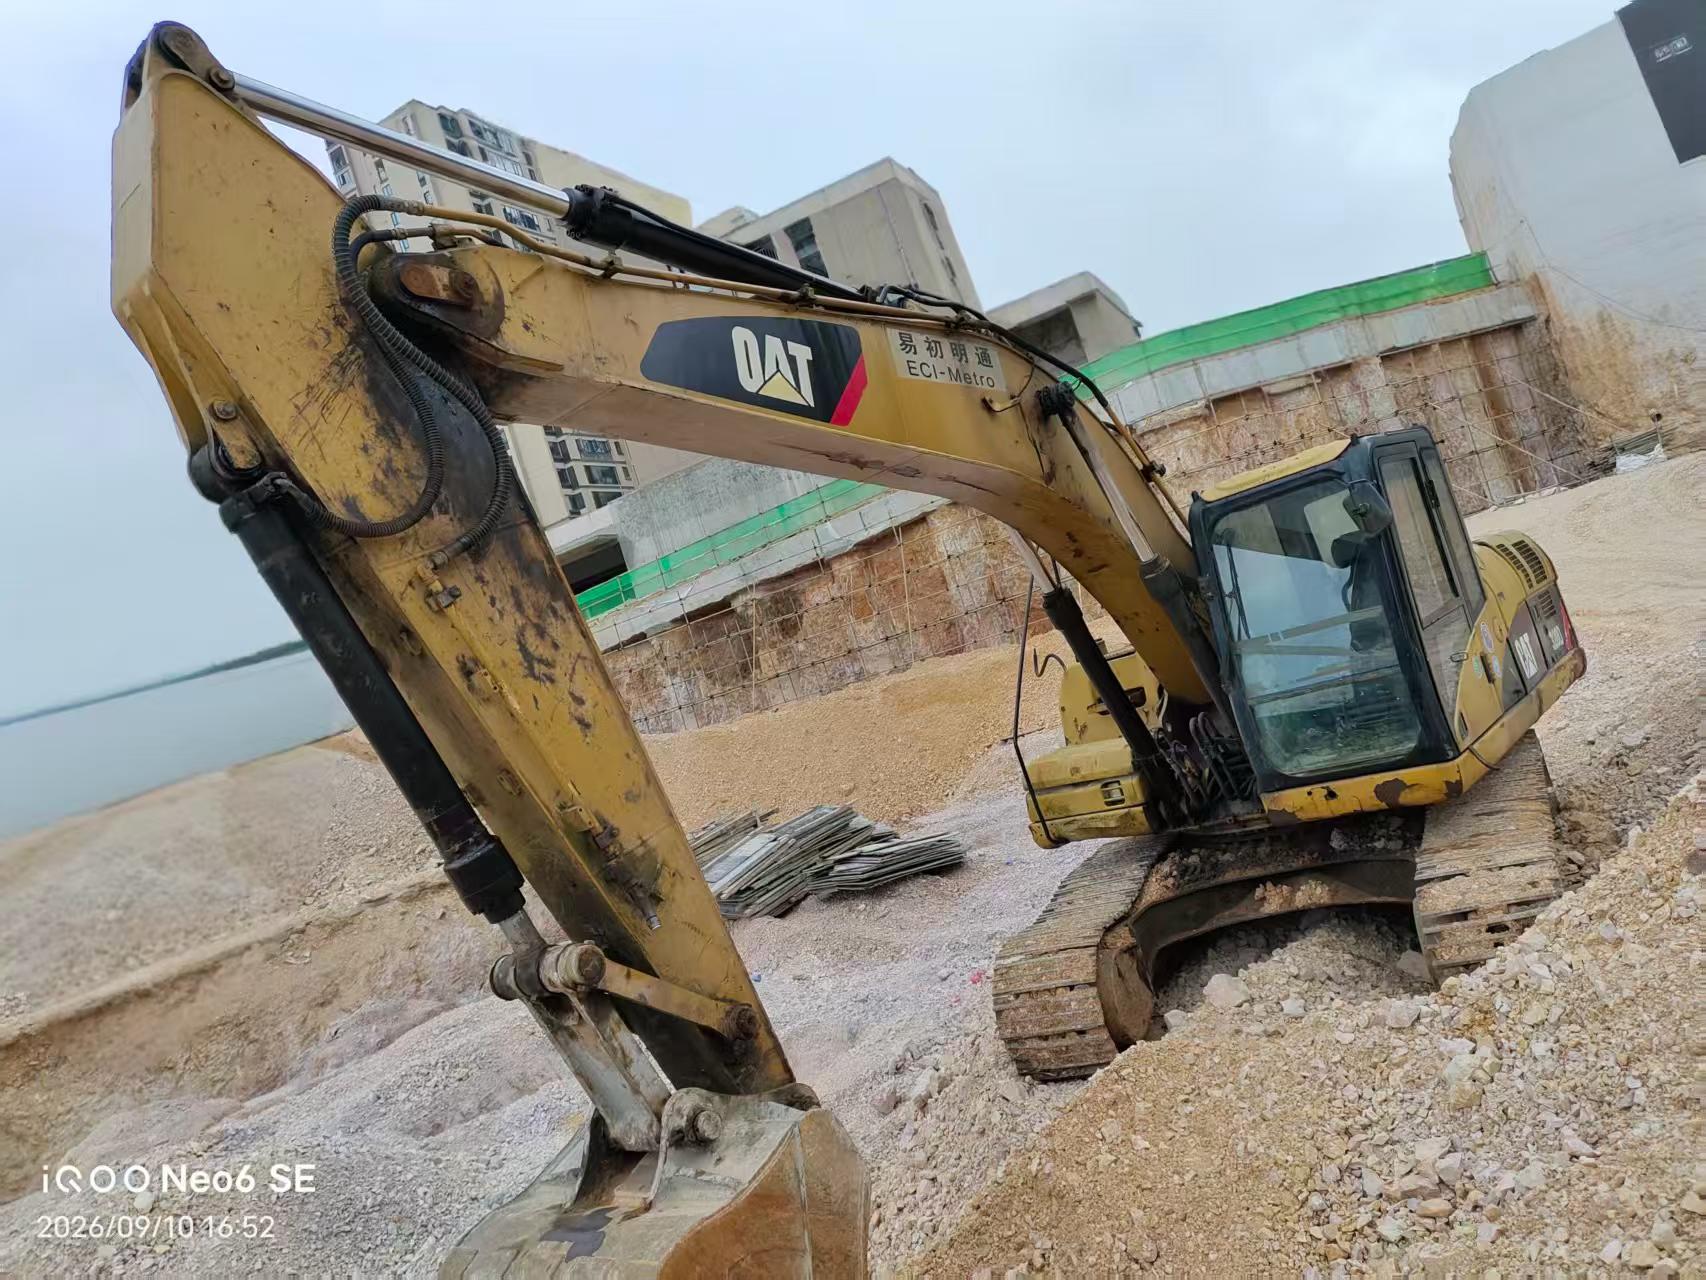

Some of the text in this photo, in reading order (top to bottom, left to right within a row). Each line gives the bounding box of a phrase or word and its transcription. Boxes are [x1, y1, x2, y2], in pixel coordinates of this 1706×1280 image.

[898, 331, 994, 369] 易初明通
[906, 359, 995, 388] ECI-Metro
